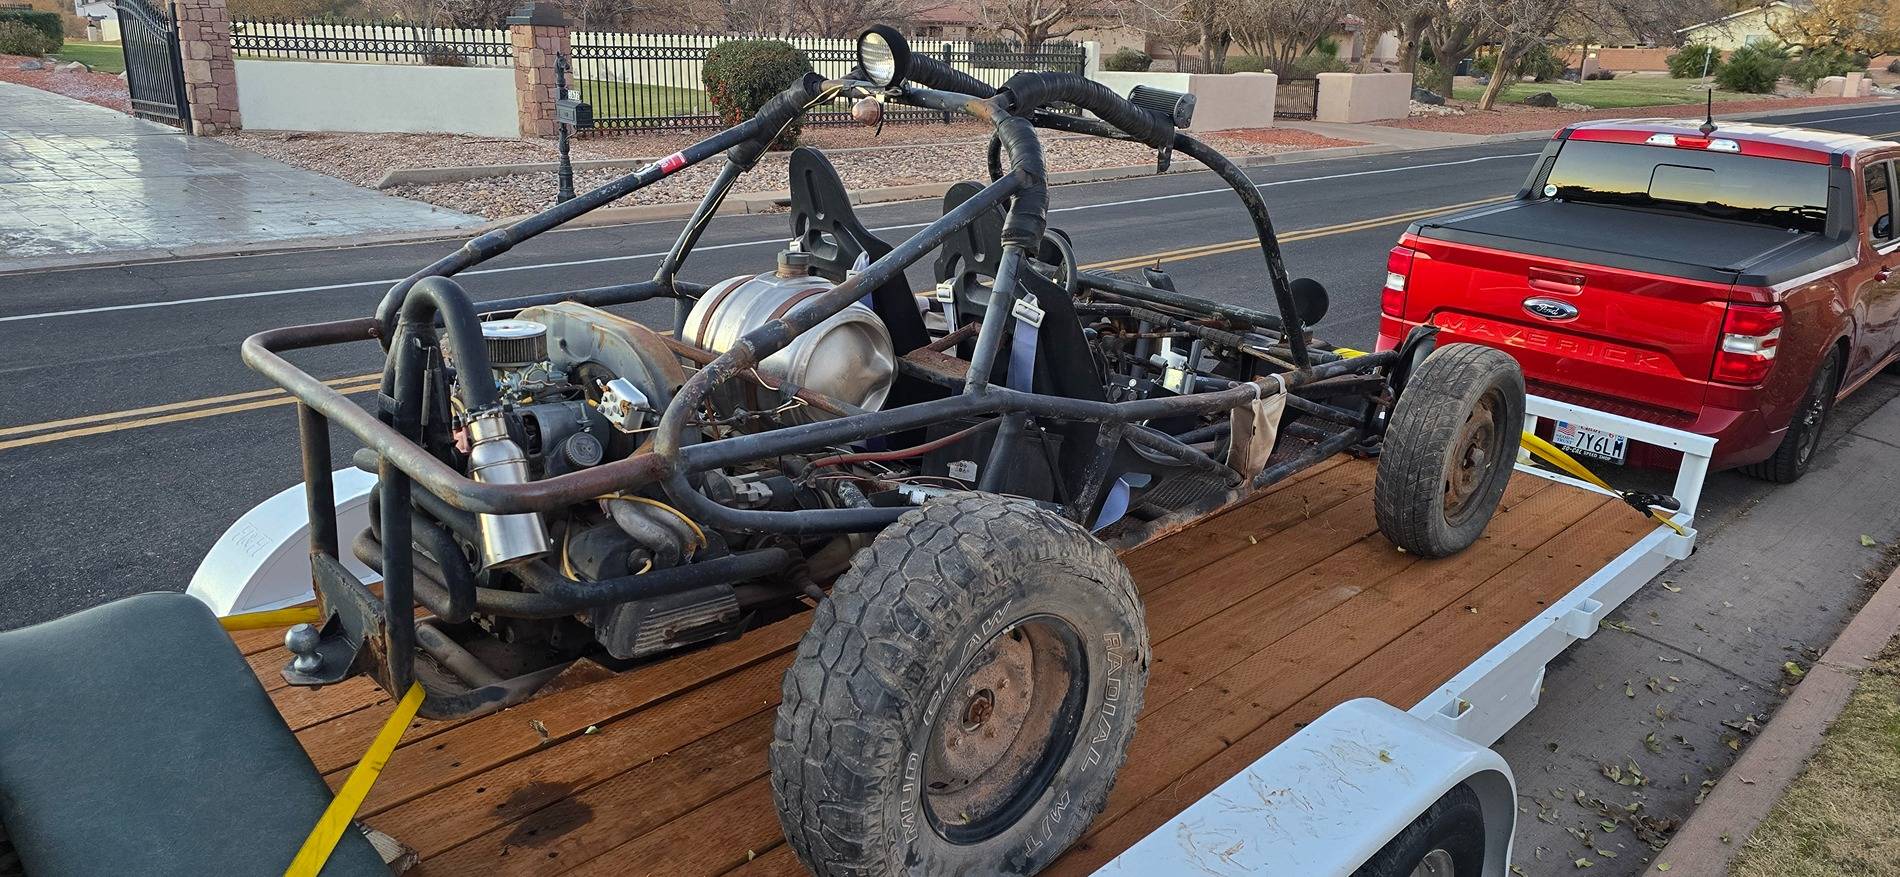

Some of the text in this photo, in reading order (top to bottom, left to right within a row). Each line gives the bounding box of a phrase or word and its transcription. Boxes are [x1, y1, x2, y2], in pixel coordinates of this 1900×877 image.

[1442, 317, 1660, 369] MAVERICK
[1562, 445, 1582, 455] SO-CAL
[1583, 450, 1598, 458] SPEED
[899, 599, 1013, 844] MUD CLAW
[1080, 631, 1123, 772] RADIAL
